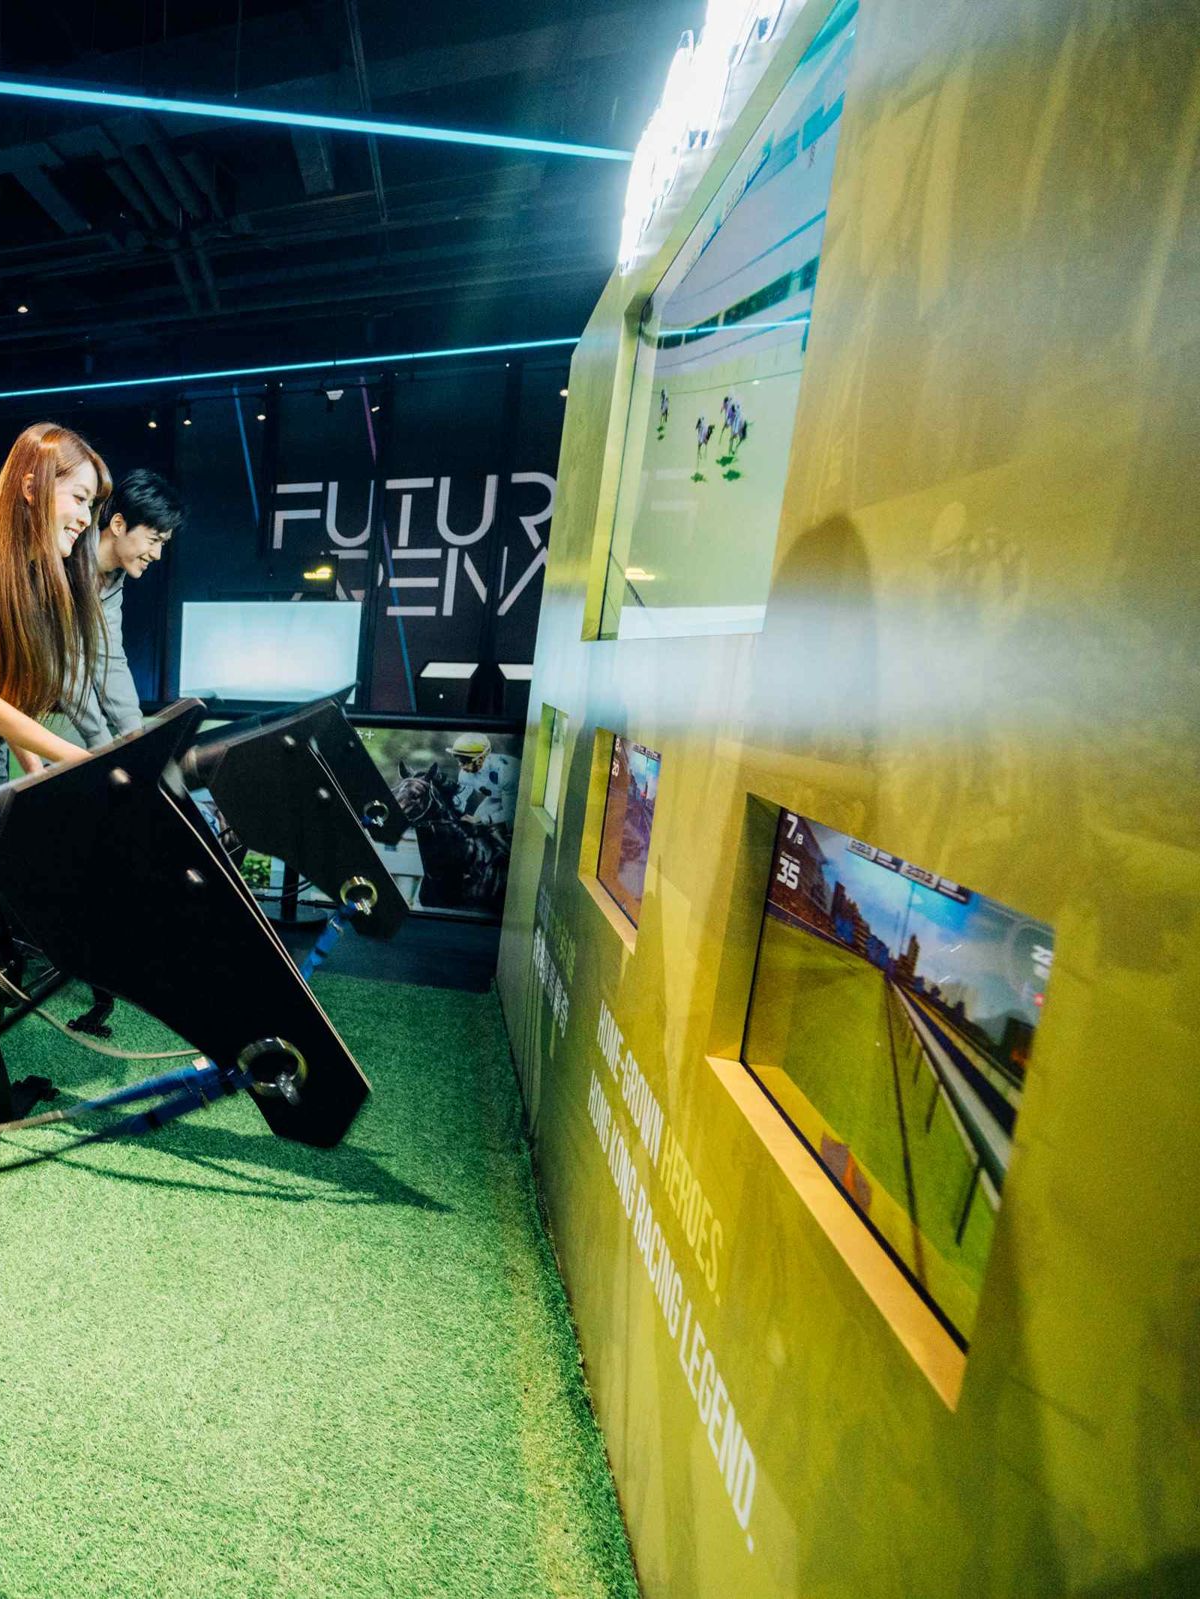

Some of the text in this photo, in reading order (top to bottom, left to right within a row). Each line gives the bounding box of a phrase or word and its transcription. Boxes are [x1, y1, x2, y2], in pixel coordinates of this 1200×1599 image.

[776, 856, 801, 890] 35
[596, 1000, 723, 1306] HOME-GROWN HEROES.
[587, 1069, 757, 1554] HONG KONG RACING LEGEND.
